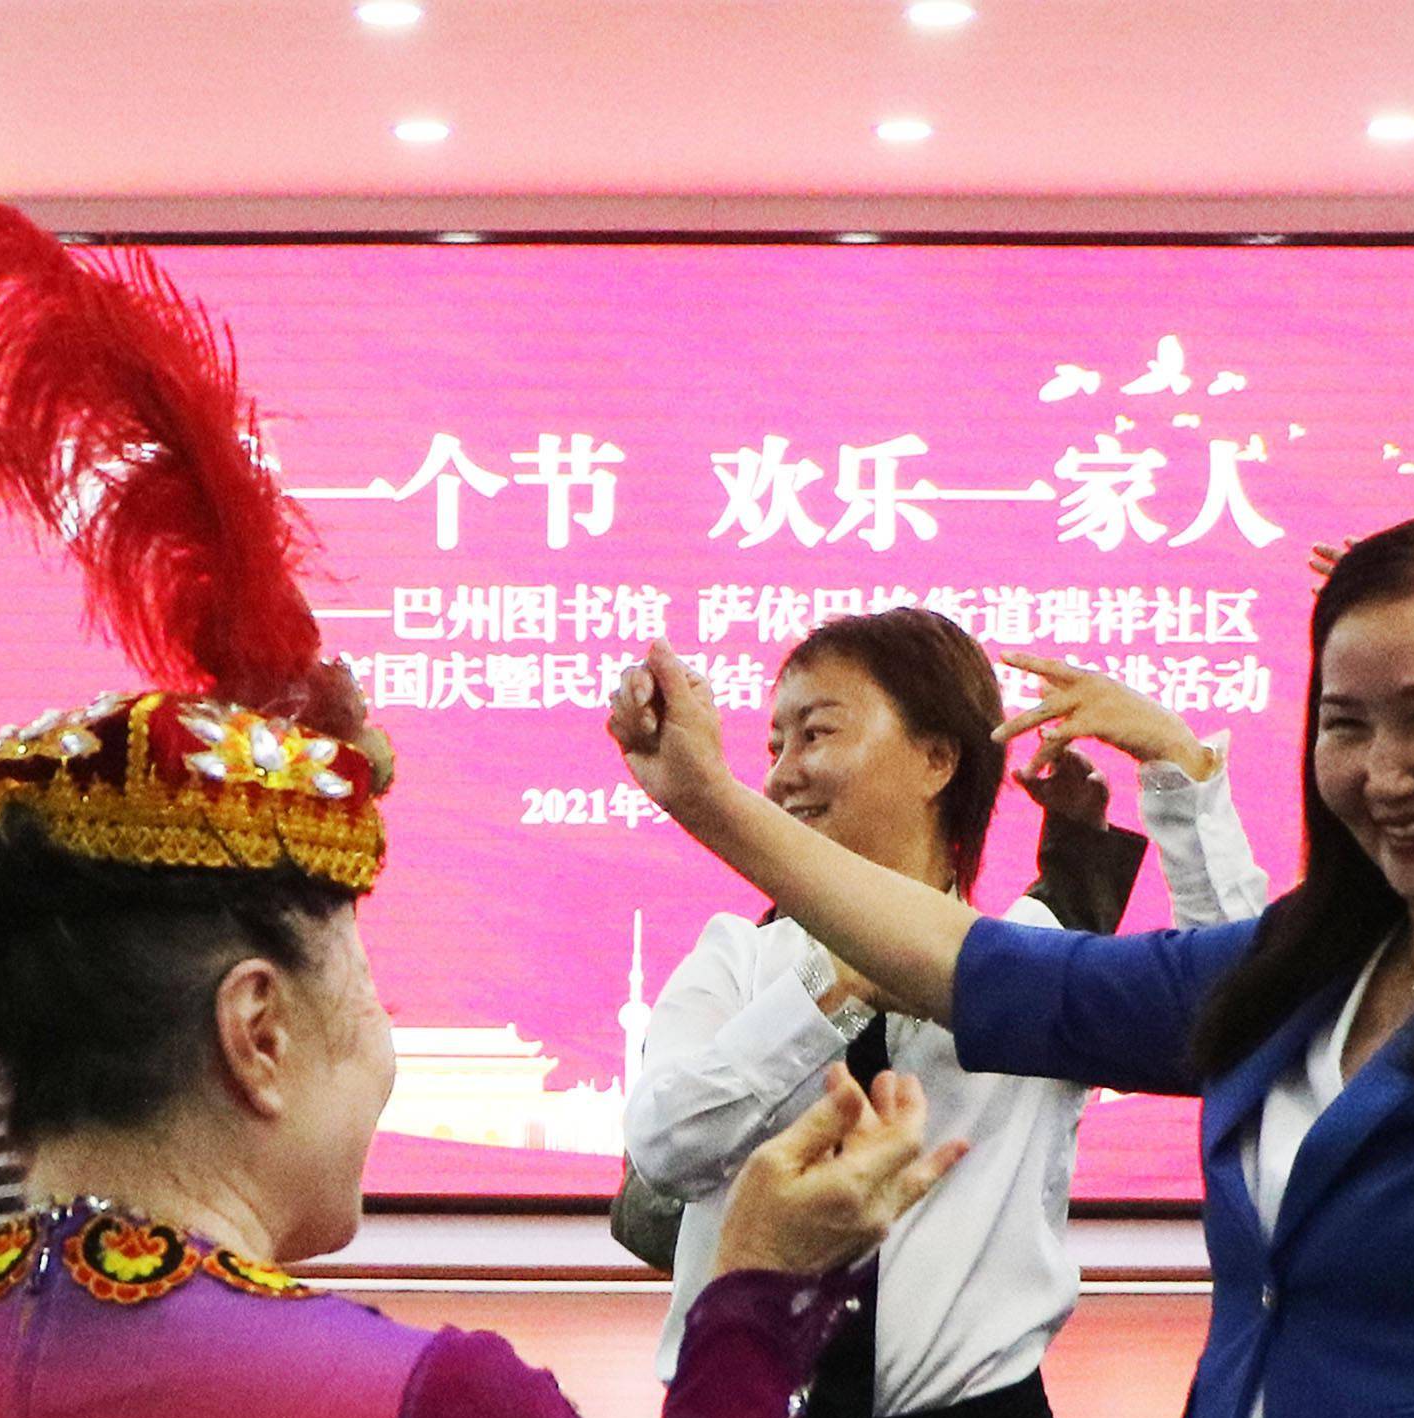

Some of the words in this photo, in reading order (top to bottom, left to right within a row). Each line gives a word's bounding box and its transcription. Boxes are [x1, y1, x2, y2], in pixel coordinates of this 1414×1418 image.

[707, 433, 1285, 551] 欢乐一家人
